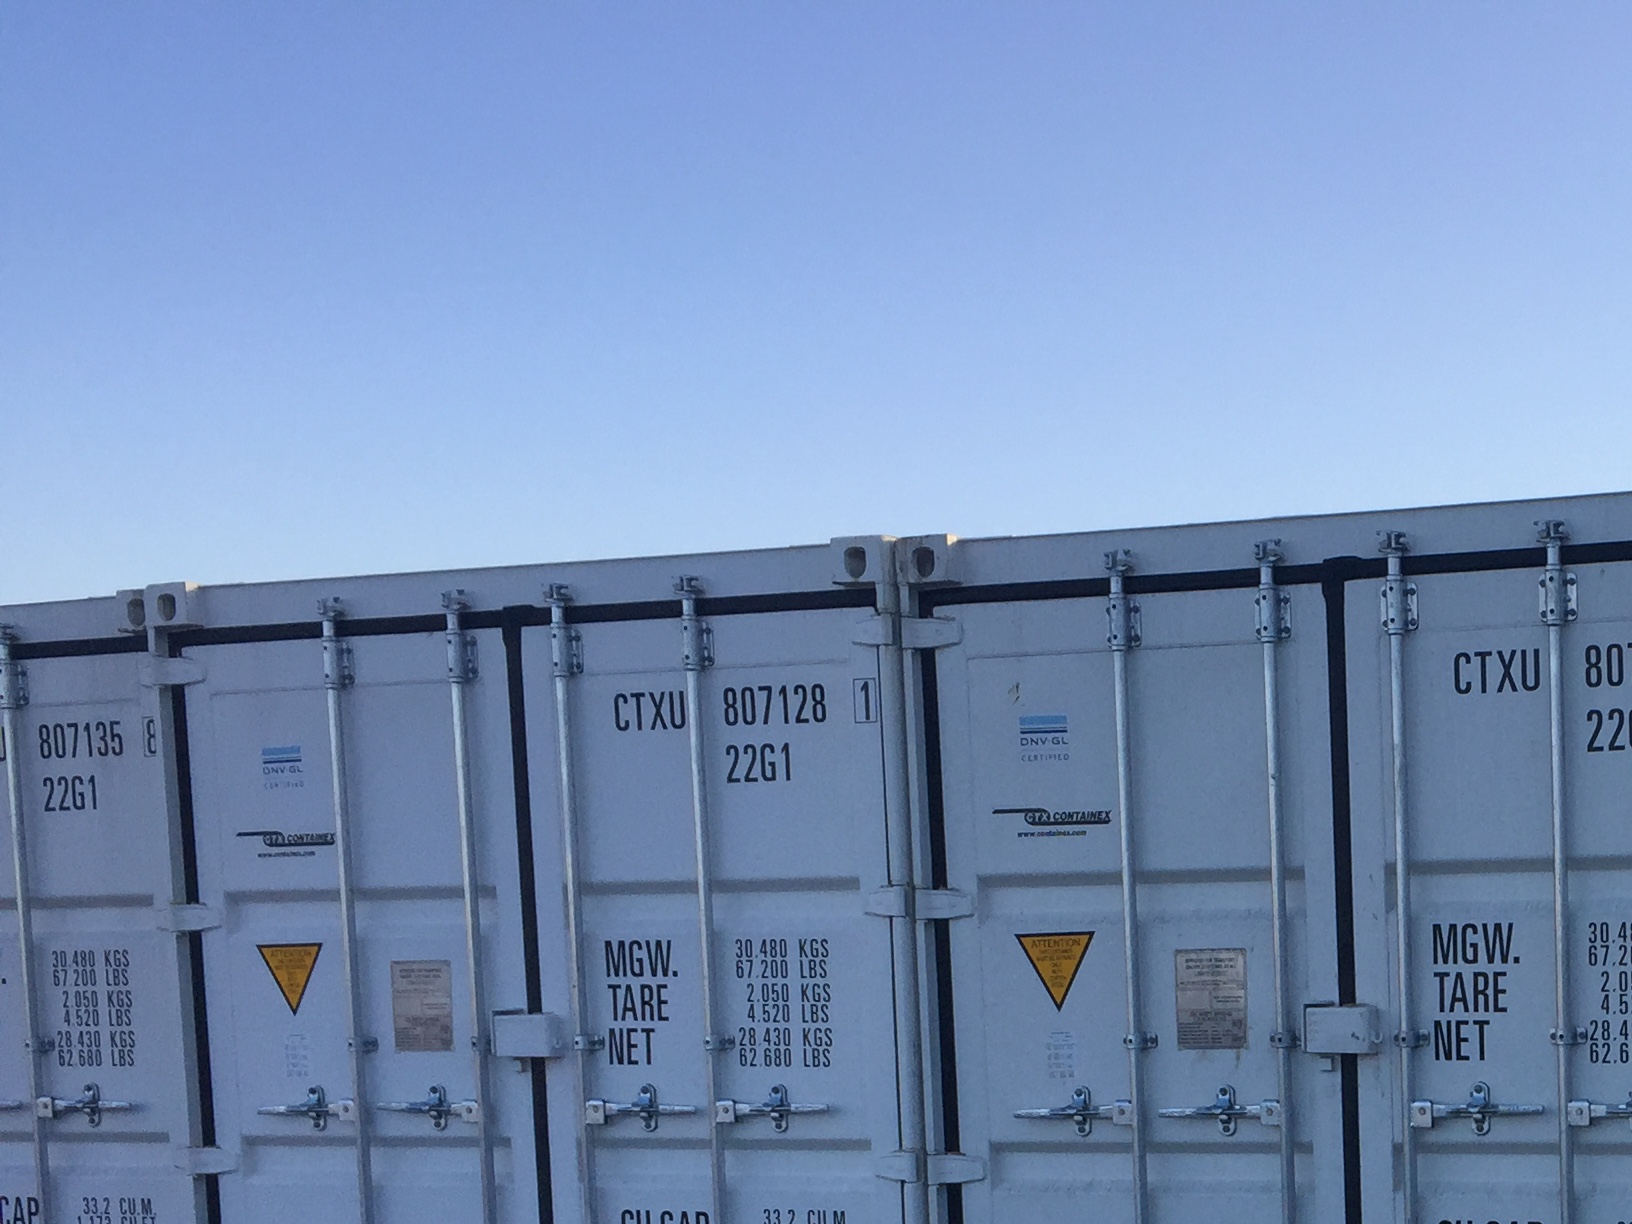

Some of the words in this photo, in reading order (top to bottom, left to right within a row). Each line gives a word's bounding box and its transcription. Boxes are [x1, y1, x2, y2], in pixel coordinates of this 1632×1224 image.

[1453, 647, 1541, 695] CTXU
[613, 690, 686, 732] CTXU
[723, 683, 827, 727] 807128
[860, 680, 871, 721] 1
[38, 720, 124, 760] 807135
[725, 742, 791, 784] 22G1
[42, 774, 97, 812] 22G1
[1053, 810, 1112, 822] CONTAINEX
[735, 938, 788, 958] 30.480
[798, 938, 829, 958] KGS
[1031, 938, 1081, 949] ATTENTION
[1432, 922, 1520, 965] MGW.
[104, 949, 130, 968] KGS
[604, 939, 679, 978] MGW.
[735, 959, 789, 979] 67.200
[799, 958, 828, 979] LBS
[105, 968, 130, 987] LBS
[106, 989, 133, 1008] KGS
[607, 983, 670, 1022] TARE
[746, 982, 790, 1003] 2.050
[800, 982, 831, 1003] KGS
[1433, 971, 1508, 1013] TARE
[108, 1009, 132, 1027] LBS
[747, 1003, 791, 1024] 4.520
[801, 1003, 830, 1024] LBS
[109, 1030, 136, 1049] KGS
[608, 1027, 656, 1066] NET
[738, 1026, 791, 1047] 28.430
[802, 1027, 833, 1048] KGS
[1433, 1019, 1491, 1061] NET
[110, 1049, 135, 1067] LBS
[739, 1047, 792, 1068] 62.680
[803, 1047, 831, 1068] LBS
